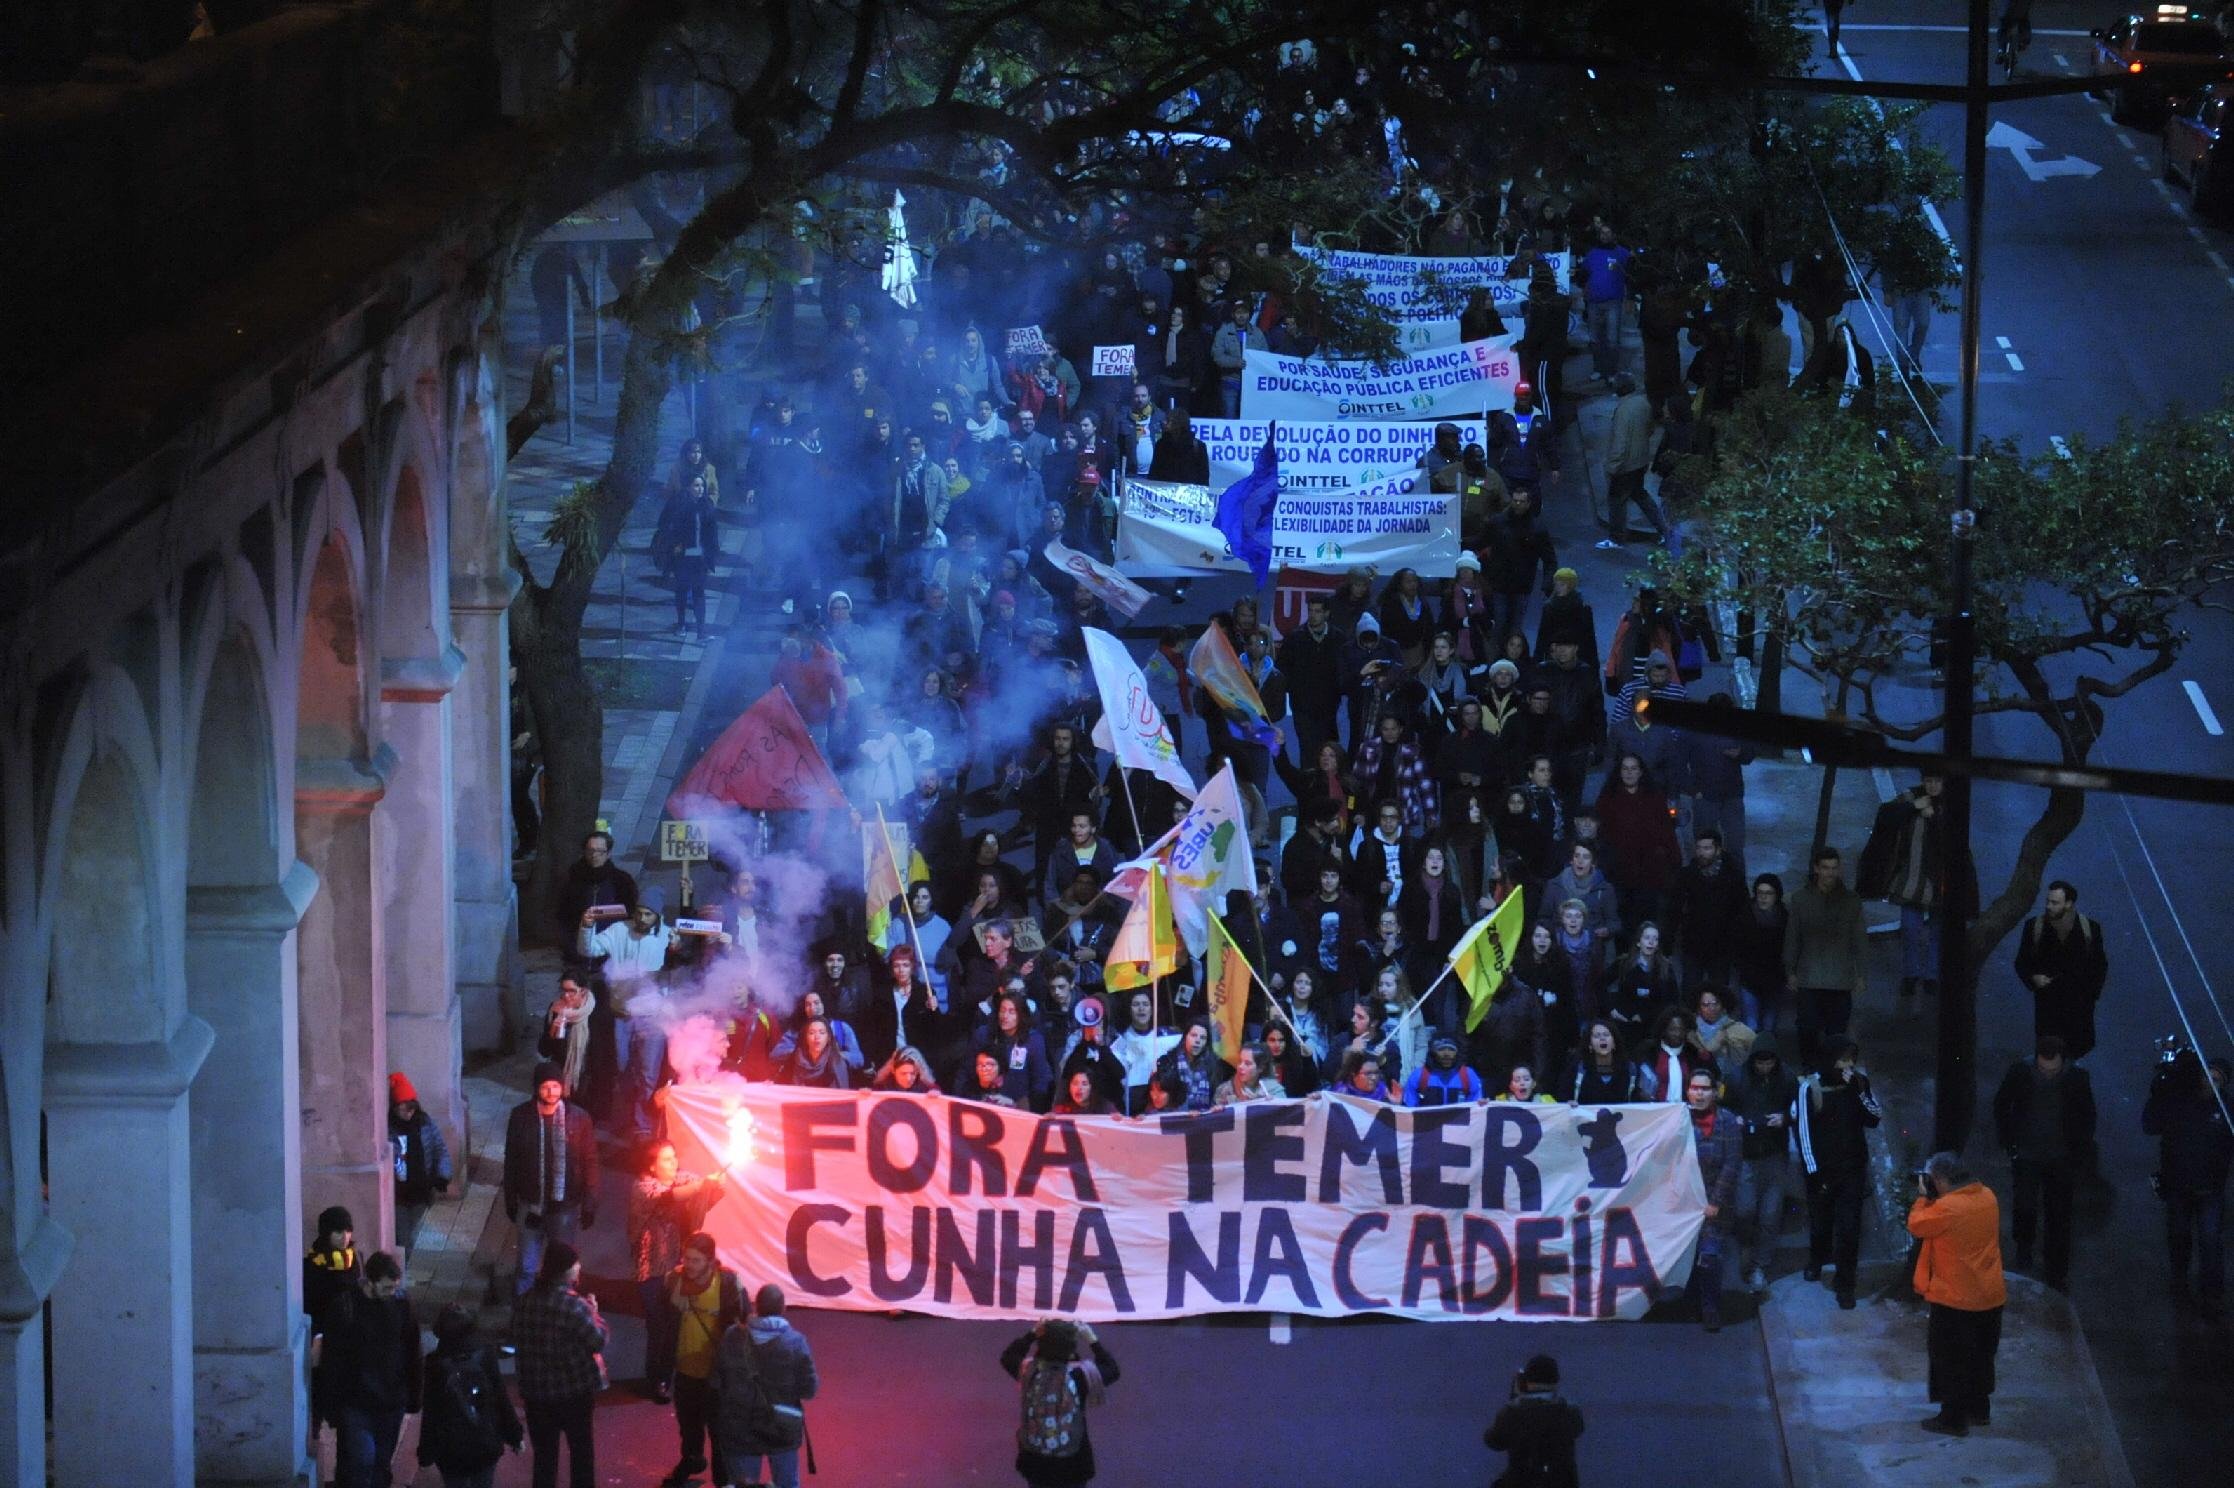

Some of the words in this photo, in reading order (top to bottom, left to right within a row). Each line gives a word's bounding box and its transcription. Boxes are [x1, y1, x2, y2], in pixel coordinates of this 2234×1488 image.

[1319, 251, 1417, 272] RABALHADORES
[1010, 327, 1038, 343] ORA
[1101, 348, 1134, 363] FORA
[1278, 361, 1308, 376] POR
[1475, 346, 1486, 361] E
[1257, 376, 1341, 397] EDUCAÇÃO
[1345, 381, 1414, 396] PÚBLICA
[1418, 362, 1509, 391] EFICIENTES
[1357, 428, 1382, 444] DO
[1388, 426, 1477, 444] DINHO
[1307, 447, 1331, 463] NA
[1279, 501, 1353, 516] CONQUISTAS
[1357, 500, 1447, 516] TRABALHISTAS:
[1273, 517, 1353, 534] LEXIBILIDADE
[1357, 519, 1372, 533] DA
[1375, 517, 1431, 534] JORNADA
[782, 1097, 1099, 1201] FORA
[1160, 1102, 1542, 1211] TEMER
[786, 1204, 1136, 1312] CUNHA
[1166, 1207, 1322, 1309] NA
